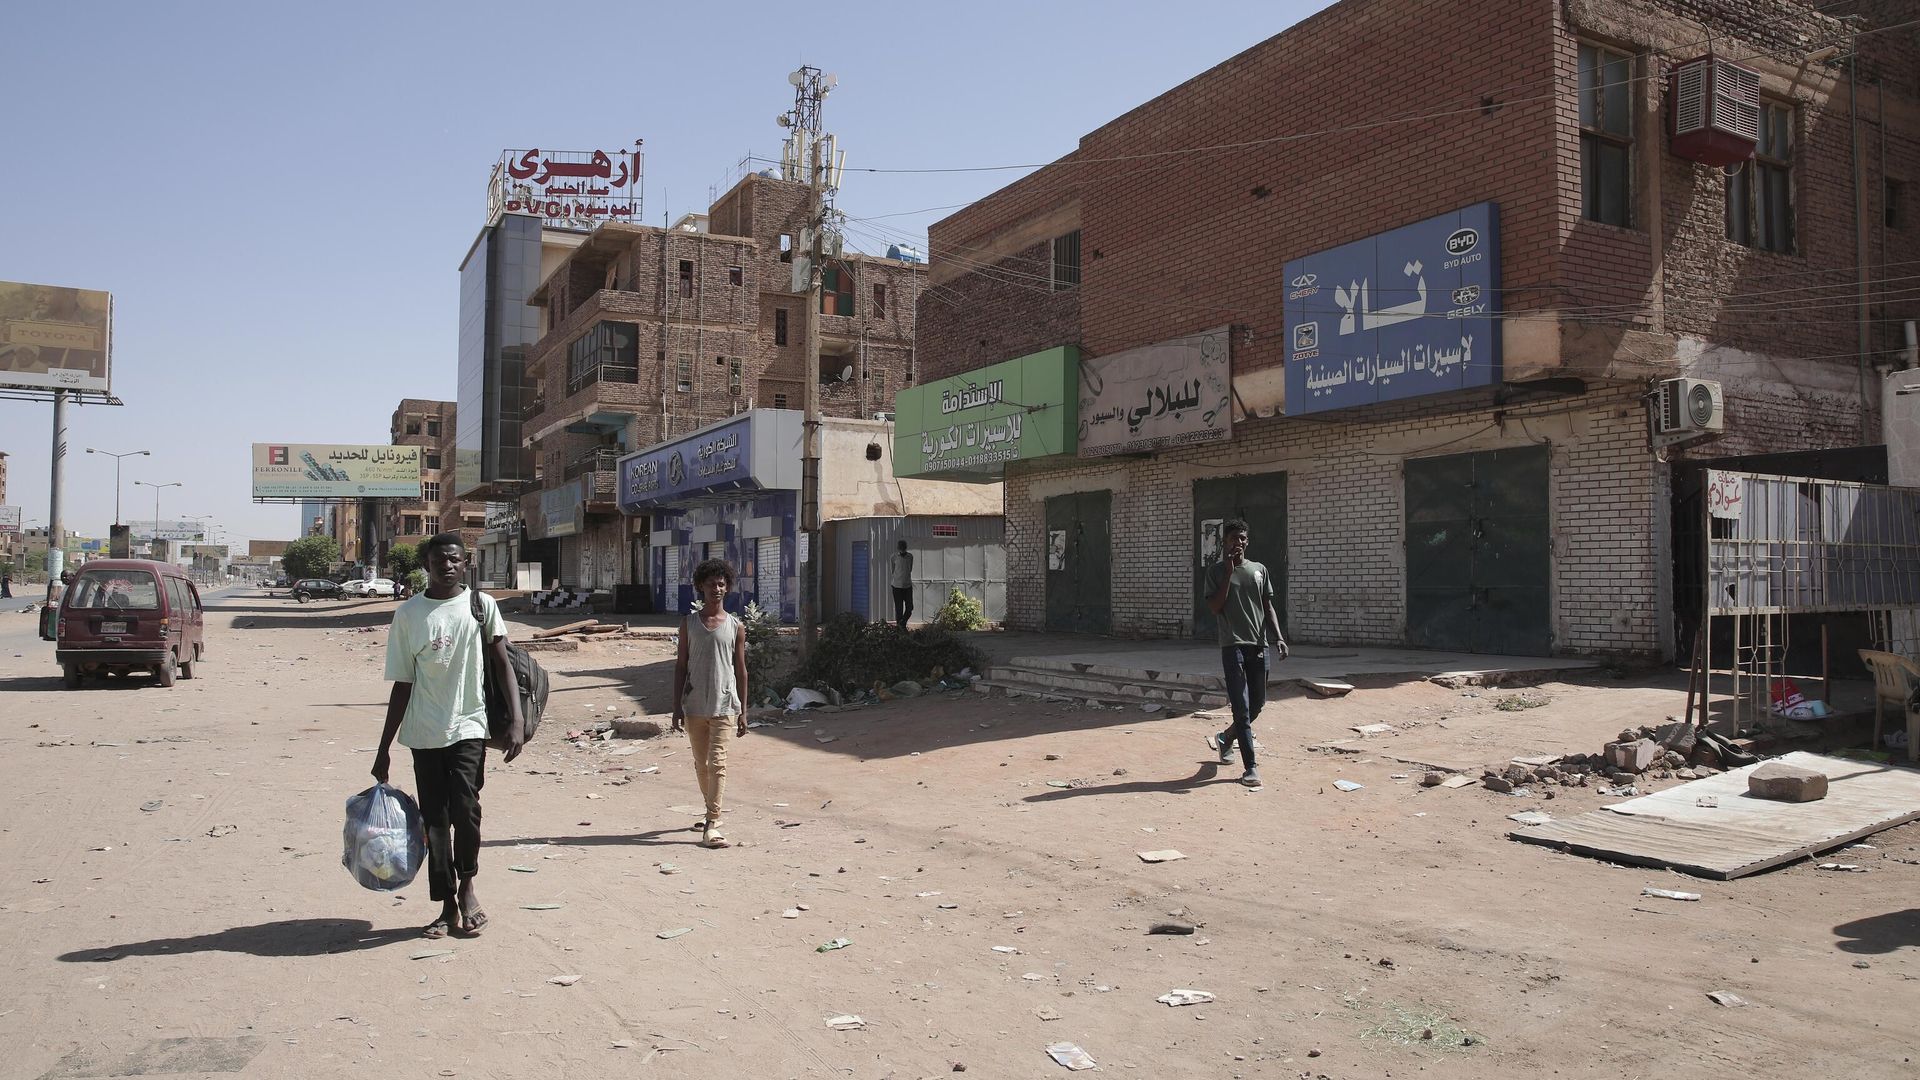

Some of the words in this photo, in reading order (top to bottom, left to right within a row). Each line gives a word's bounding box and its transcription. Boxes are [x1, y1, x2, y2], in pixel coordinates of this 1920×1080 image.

[587, 184, 610, 199] عبد
[1449, 233, 1475, 250] BYD
[1443, 258, 1459, 270] BYD
[1461, 253, 1482, 266] AUTO
[1446, 303, 1486, 320] GEELY
[18, 329, 89, 342] TOYOTA
[1355, 346, 1411, 385] السيارات
[1306, 359, 1352, 397] الصينية
[922, 424, 962, 460] الكورية
[328, 448, 369, 464] للحديد
[371, 448, 418, 465] فيرونايل
[630, 460, 658, 479] KOREAN
